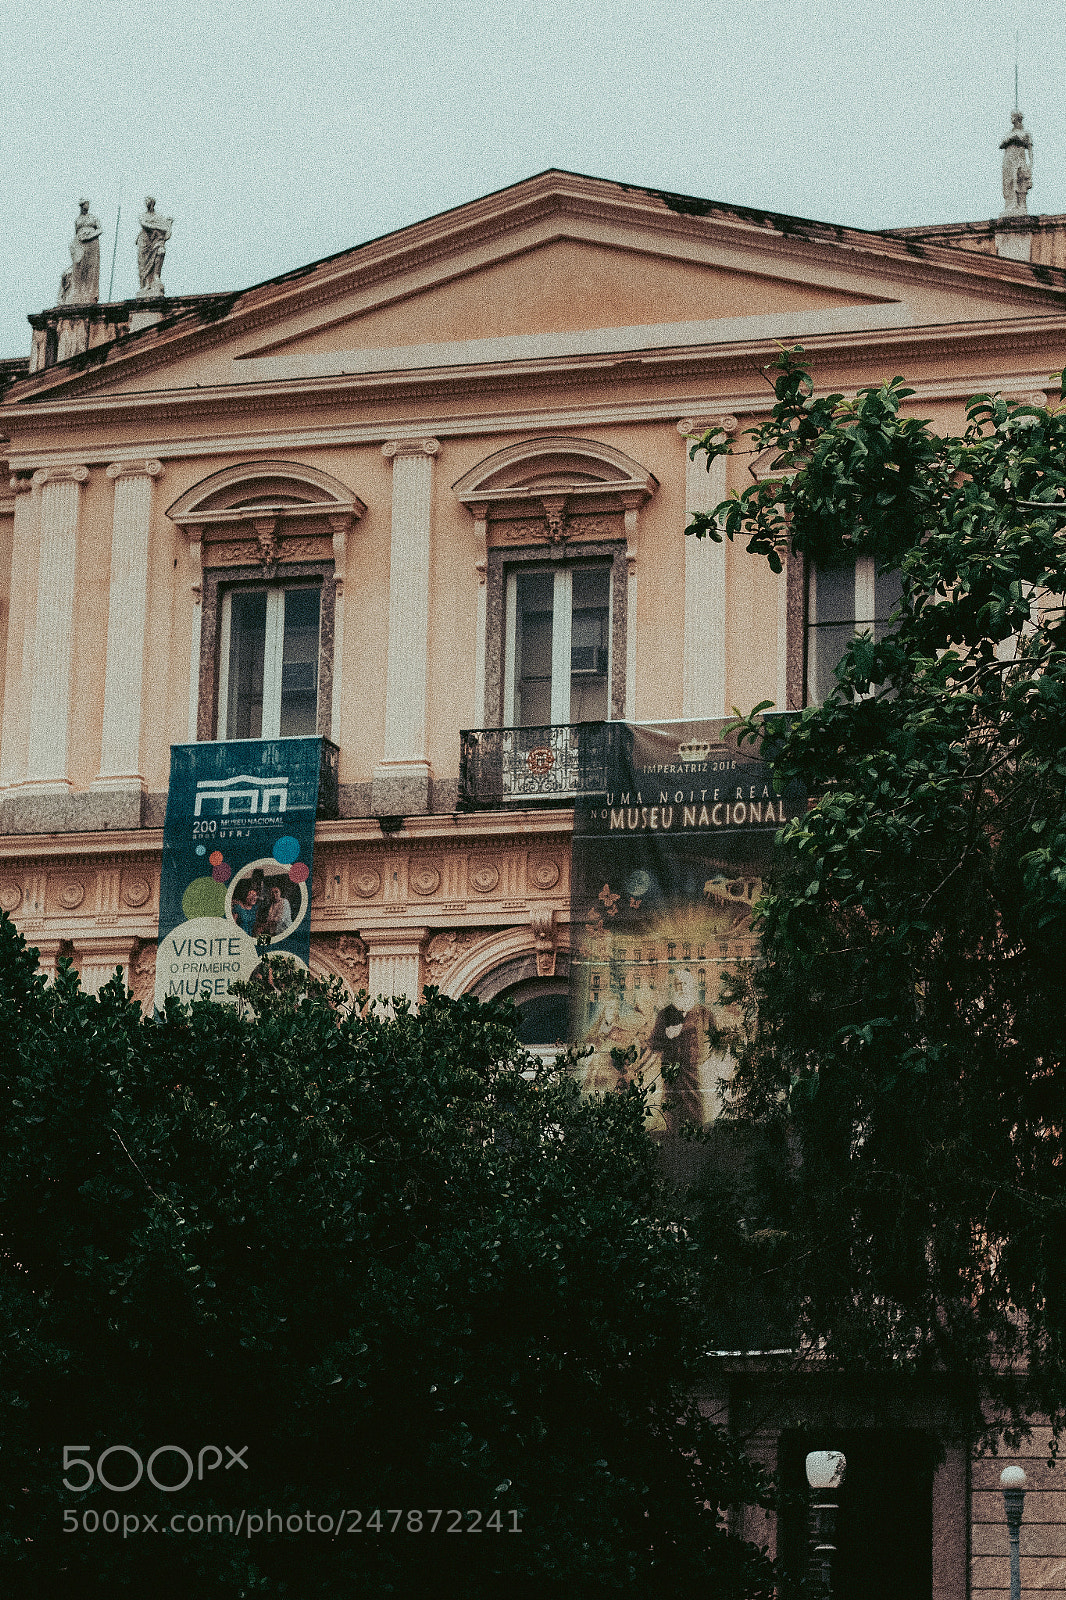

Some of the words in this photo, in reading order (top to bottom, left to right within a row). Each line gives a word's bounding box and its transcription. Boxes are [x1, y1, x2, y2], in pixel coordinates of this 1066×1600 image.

[643, 762, 708, 774] IMPERATRIZ
[606, 791, 643, 806] UMA
[659, 787, 720, 804] NOITE
[736, 784, 782, 800] REA
[246, 817, 284, 825] NACIONAL
[590, 808, 608, 819] NO
[609, 805, 673, 830] MUSEU
[683, 800, 787, 827] NACIONAL
[192, 820, 217, 834] 200
[172, 937, 241, 957] VISITE
[170, 963, 179, 974] O
[182, 961, 241, 974] PRIMEIRO
